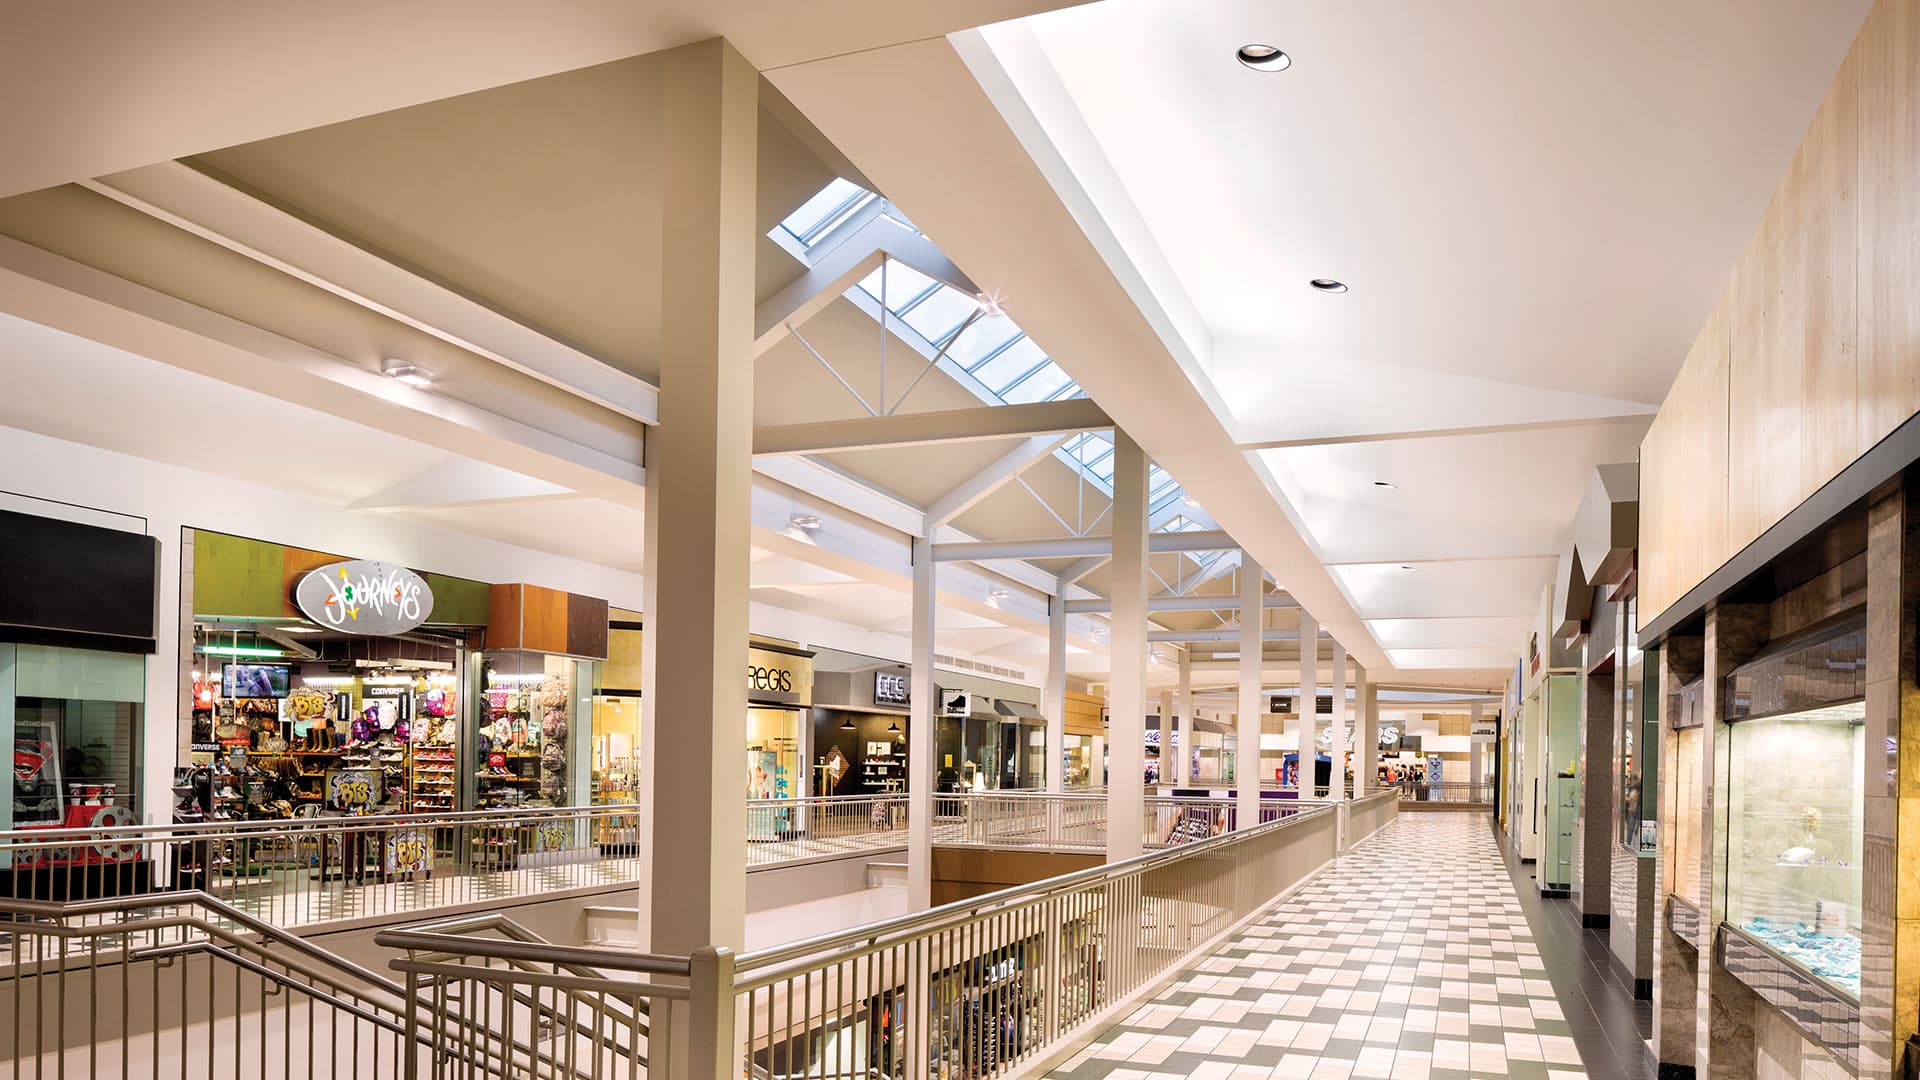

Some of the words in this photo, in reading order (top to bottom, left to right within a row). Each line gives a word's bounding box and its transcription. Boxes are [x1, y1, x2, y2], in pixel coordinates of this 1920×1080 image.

[319, 567, 421, 625] JOURNEYS
[1320, 726, 1399, 744] SES
[191, 743, 221, 751] ONVERSE
[340, 782, 368, 804] BTS
